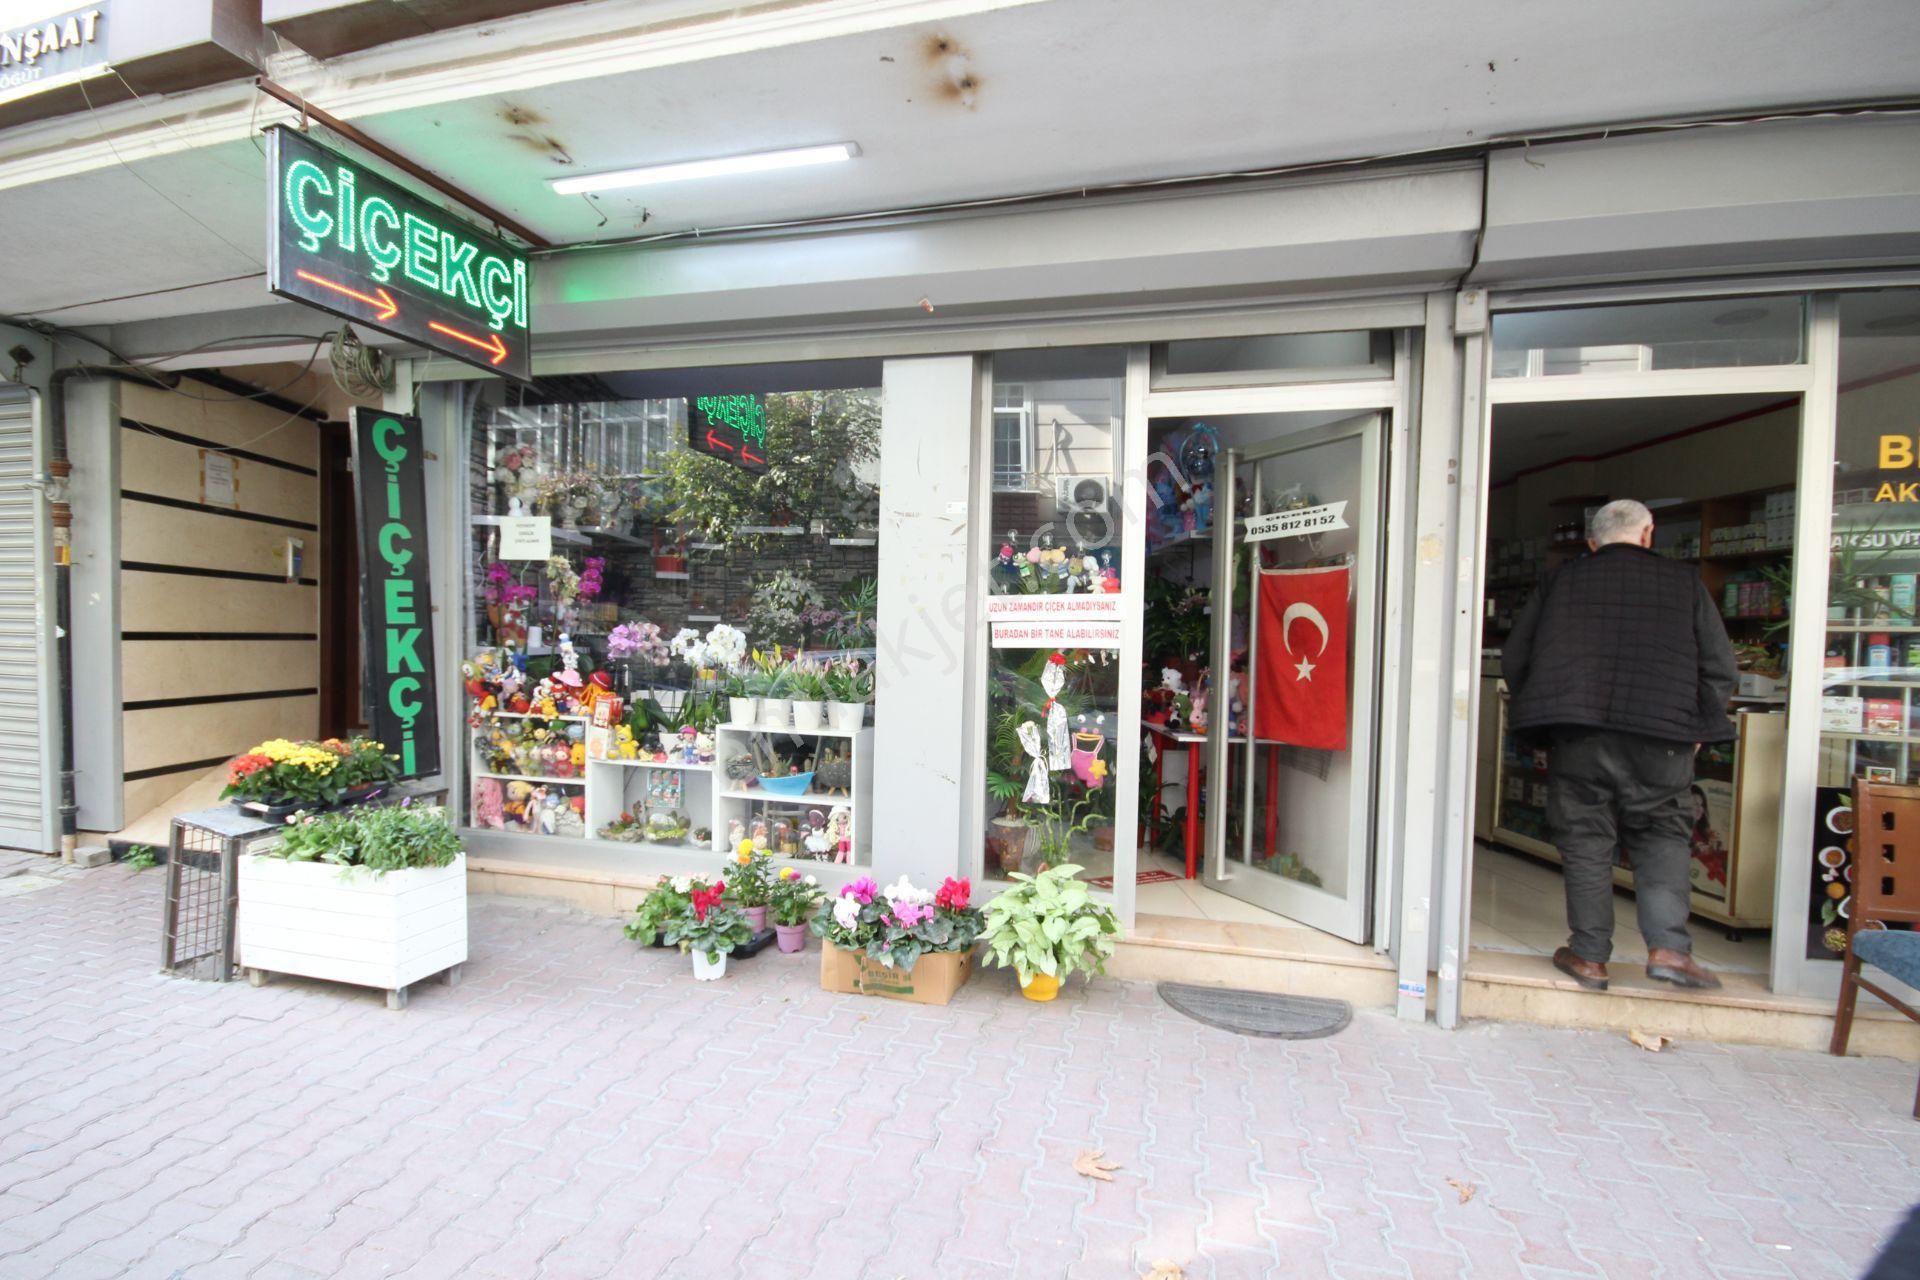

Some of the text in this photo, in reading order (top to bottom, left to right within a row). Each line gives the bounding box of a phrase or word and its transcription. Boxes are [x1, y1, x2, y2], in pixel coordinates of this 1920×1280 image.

[285, 160, 528, 331] ÇİÇEKÇİ
[1250, 514, 1336, 536] 0535 812 81 52
[372, 417, 425, 776] ÇİÇEKÇİ
[989, 601, 1007, 613] UZUN
[1009, 601, 1043, 613] ZAMANDIR
[994, 628, 1029, 639] BURADAN
[1045, 628, 1064, 639] TANE
